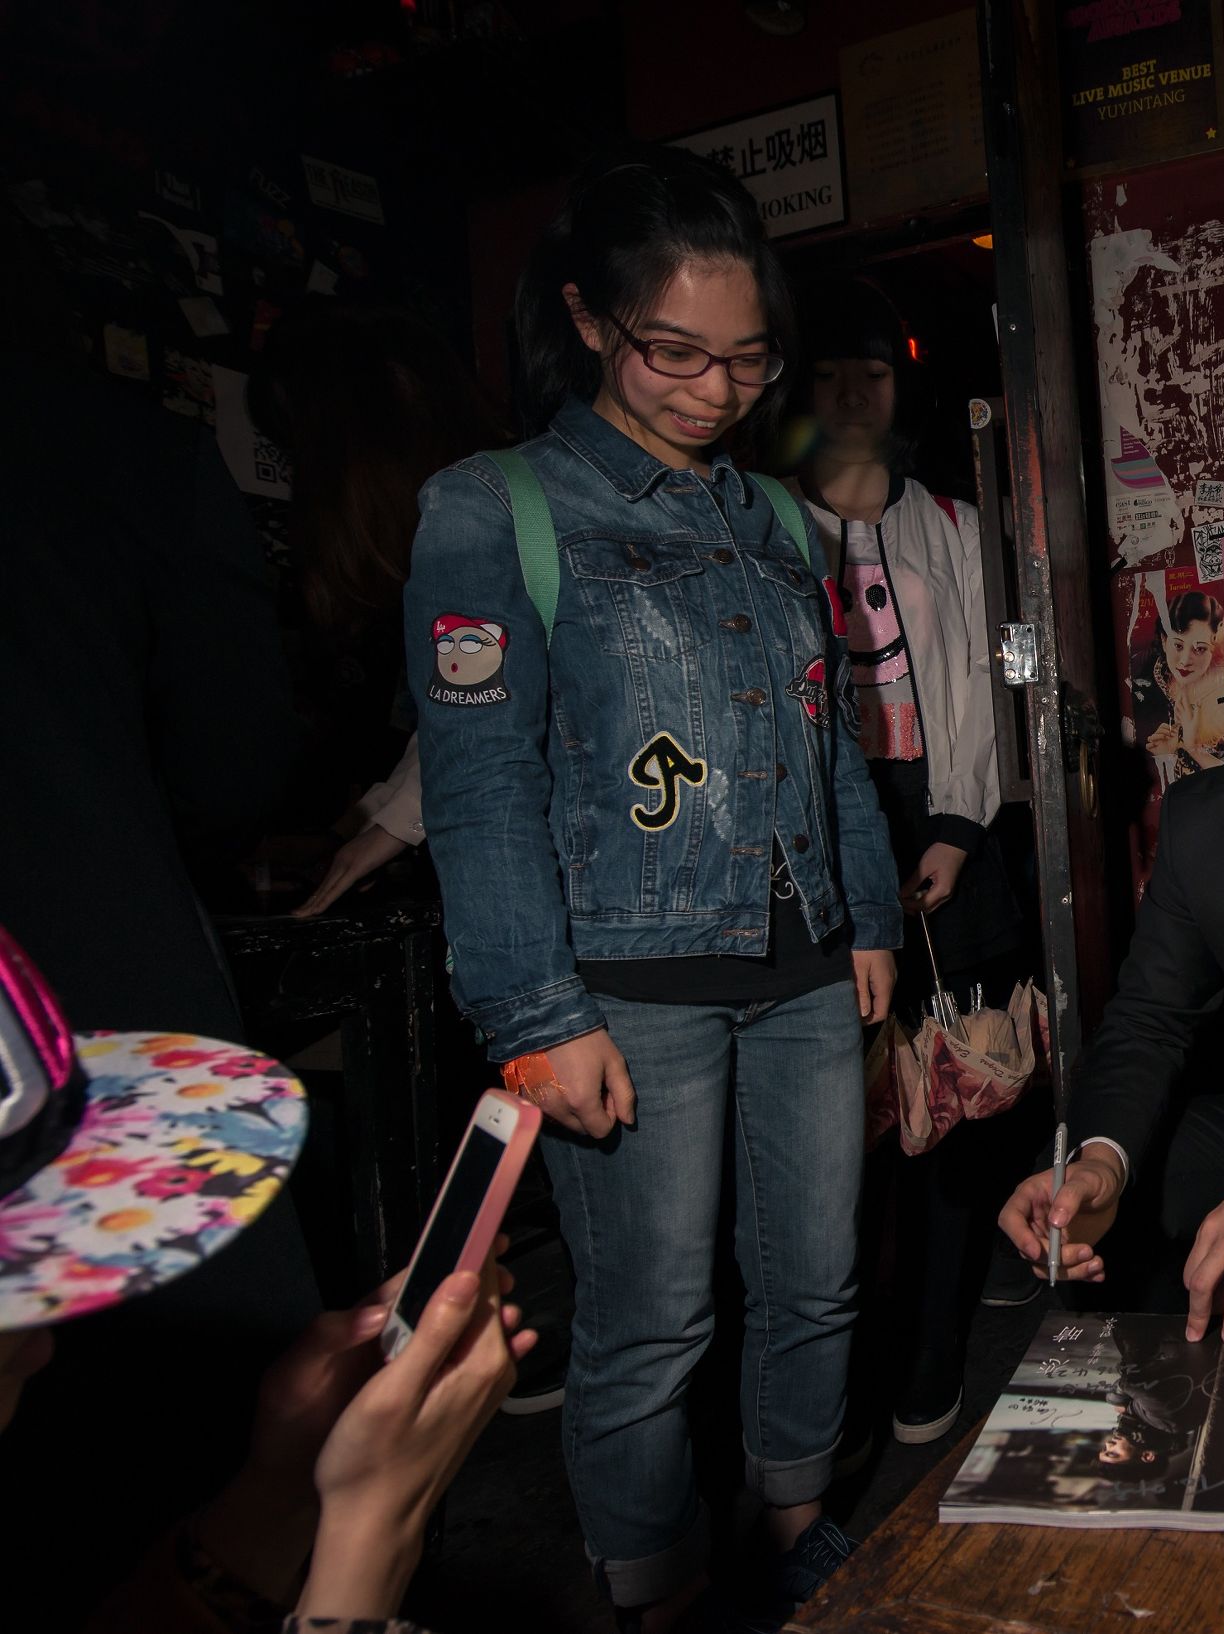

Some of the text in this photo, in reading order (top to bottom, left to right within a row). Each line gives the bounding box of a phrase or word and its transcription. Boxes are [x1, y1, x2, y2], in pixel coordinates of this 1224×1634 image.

[1121, 59, 1158, 80] BEST
[1072, 63, 1213, 107] LIVE MUSIC VENUE
[1097, 89, 1185, 121] YUYINTANG
[442, 686, 507, 704] DREAMERS
